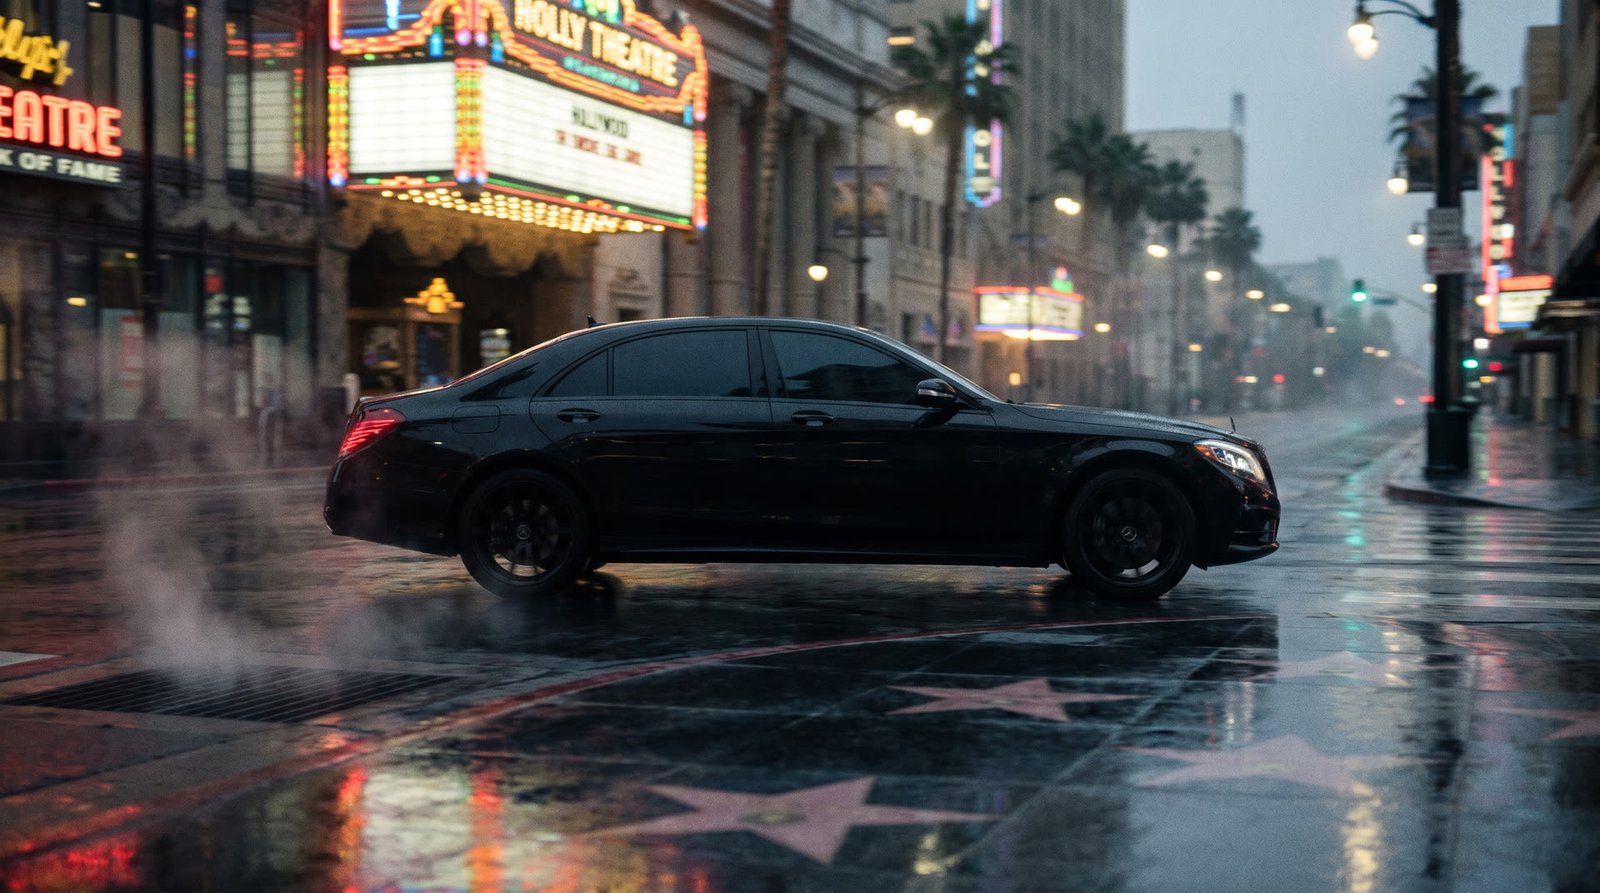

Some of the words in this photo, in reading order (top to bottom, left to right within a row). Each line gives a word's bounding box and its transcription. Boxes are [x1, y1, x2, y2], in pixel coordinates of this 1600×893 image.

[0, 84, 122, 157] EATRE
[18, 152, 53, 171] OF
[56, 158, 121, 183] FAME
